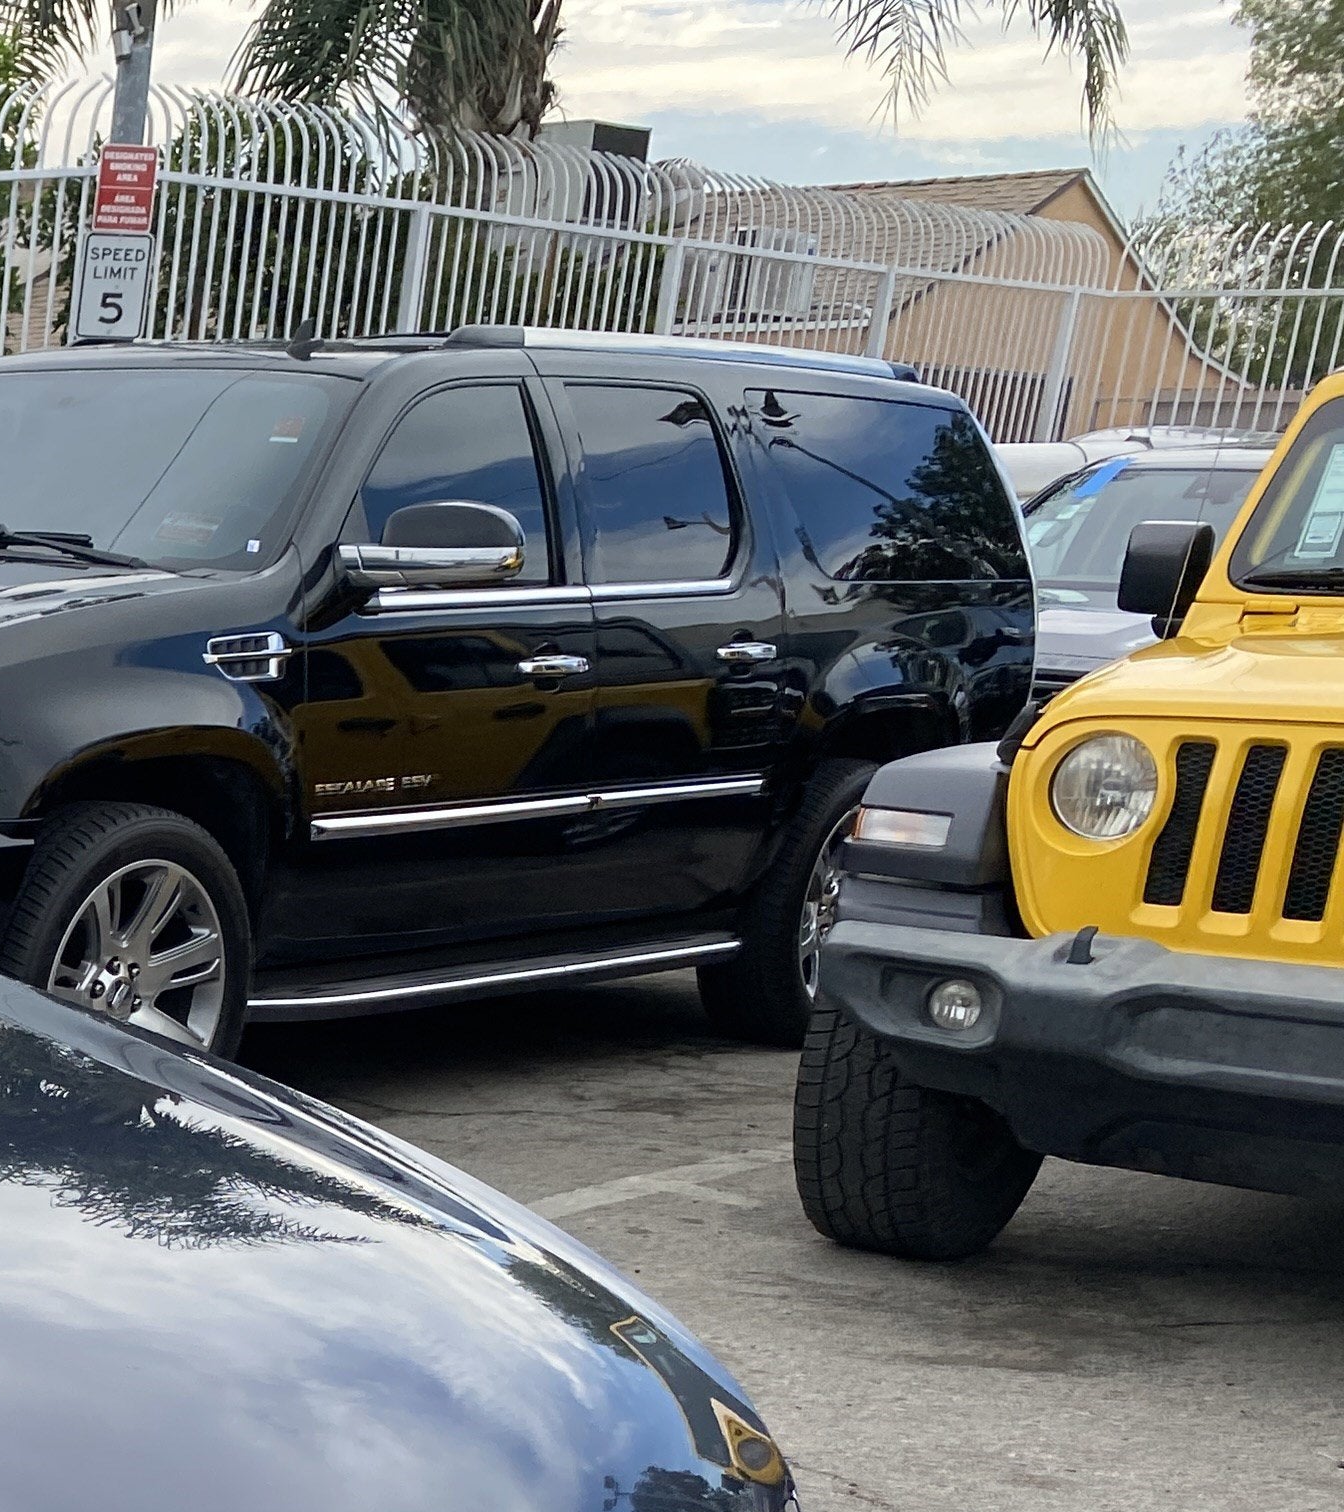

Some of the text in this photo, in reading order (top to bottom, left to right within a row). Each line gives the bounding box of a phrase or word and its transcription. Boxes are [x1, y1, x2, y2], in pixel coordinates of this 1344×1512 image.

[89, 247, 146, 262] SPEED
[93, 266, 138, 281] LIMIT
[98, 292, 124, 324] 5
